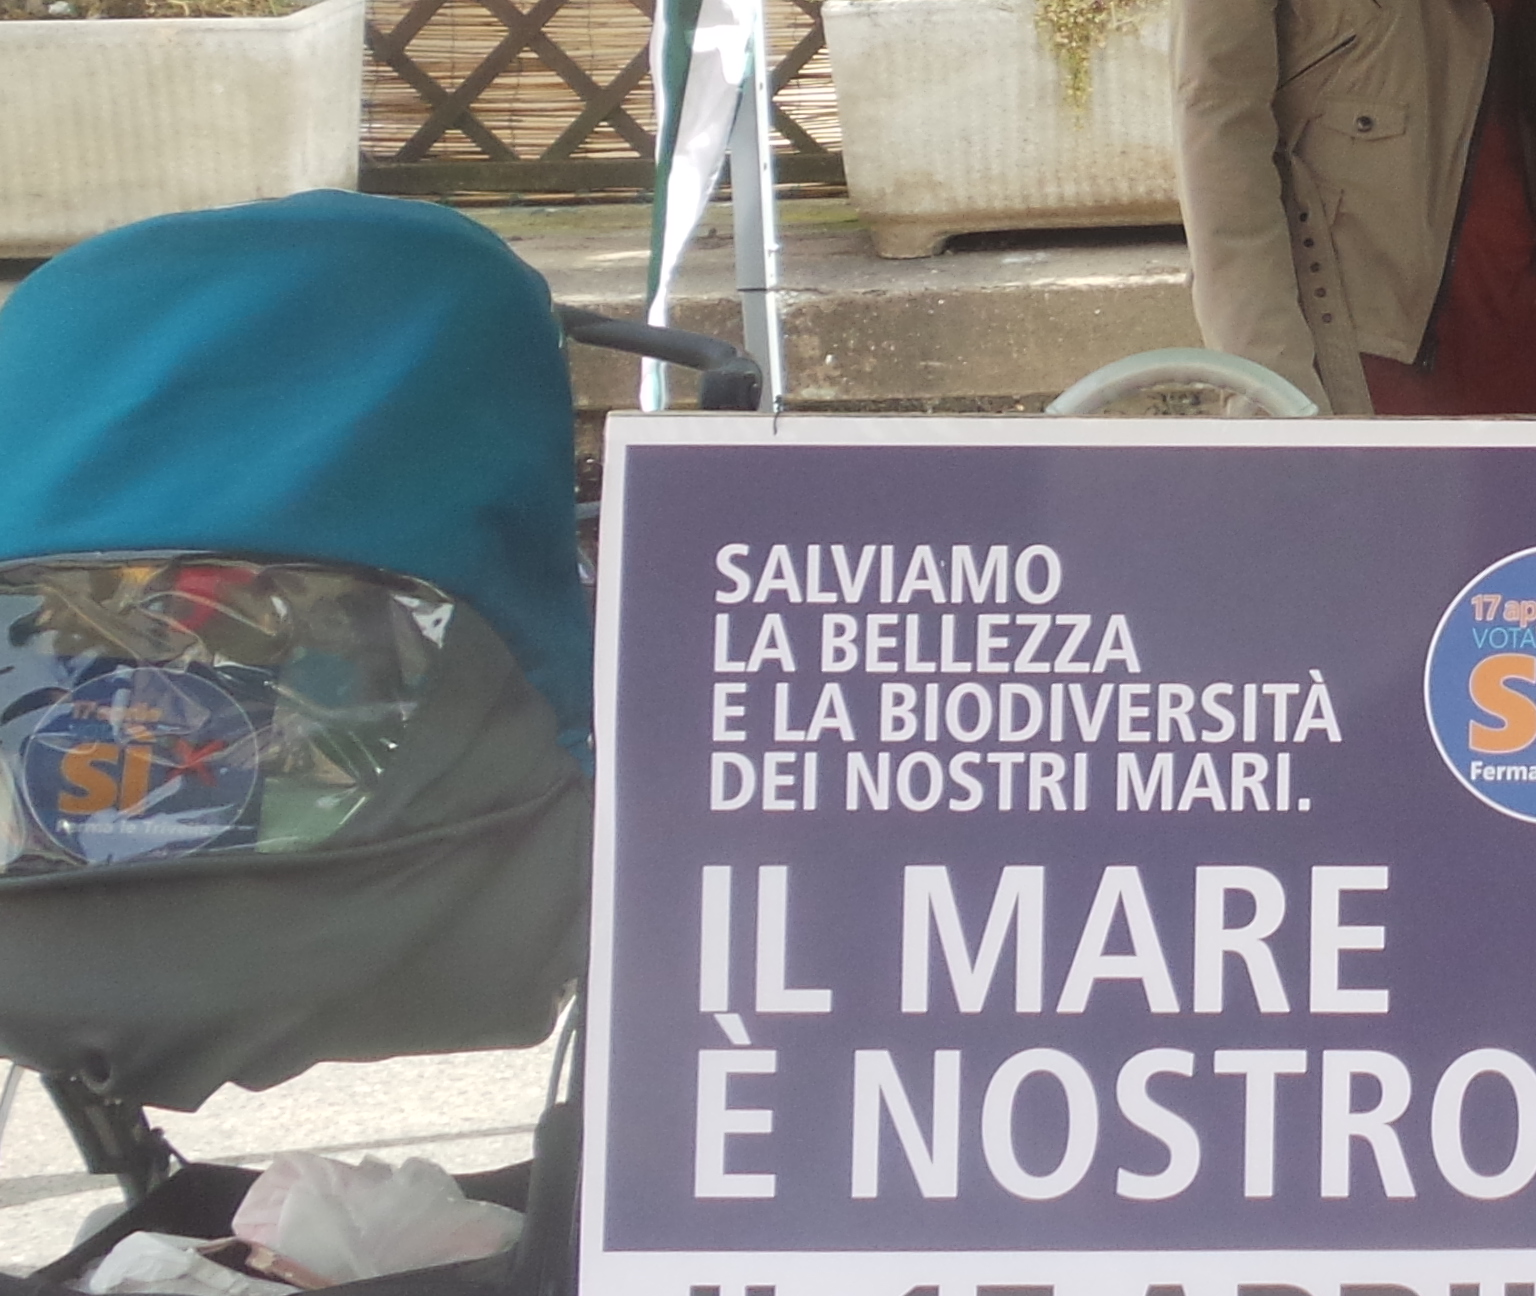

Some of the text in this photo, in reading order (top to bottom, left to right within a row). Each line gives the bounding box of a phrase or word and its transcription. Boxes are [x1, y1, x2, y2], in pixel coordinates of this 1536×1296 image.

[715, 544, 1062, 605] SALVIAMO
[1471, 594, 1501, 621] 17
[714, 614, 1140, 673] LA BELLEZZA
[1472, 627, 1536, 649] VOTA
[713, 670, 1342, 742] E LA BIODIVERSITÀ
[711, 753, 1311, 811] DEI NOSTRI MARI.
[700, 866, 1390, 1014] IL MARE
[694, 1013, 776, 1198] È
